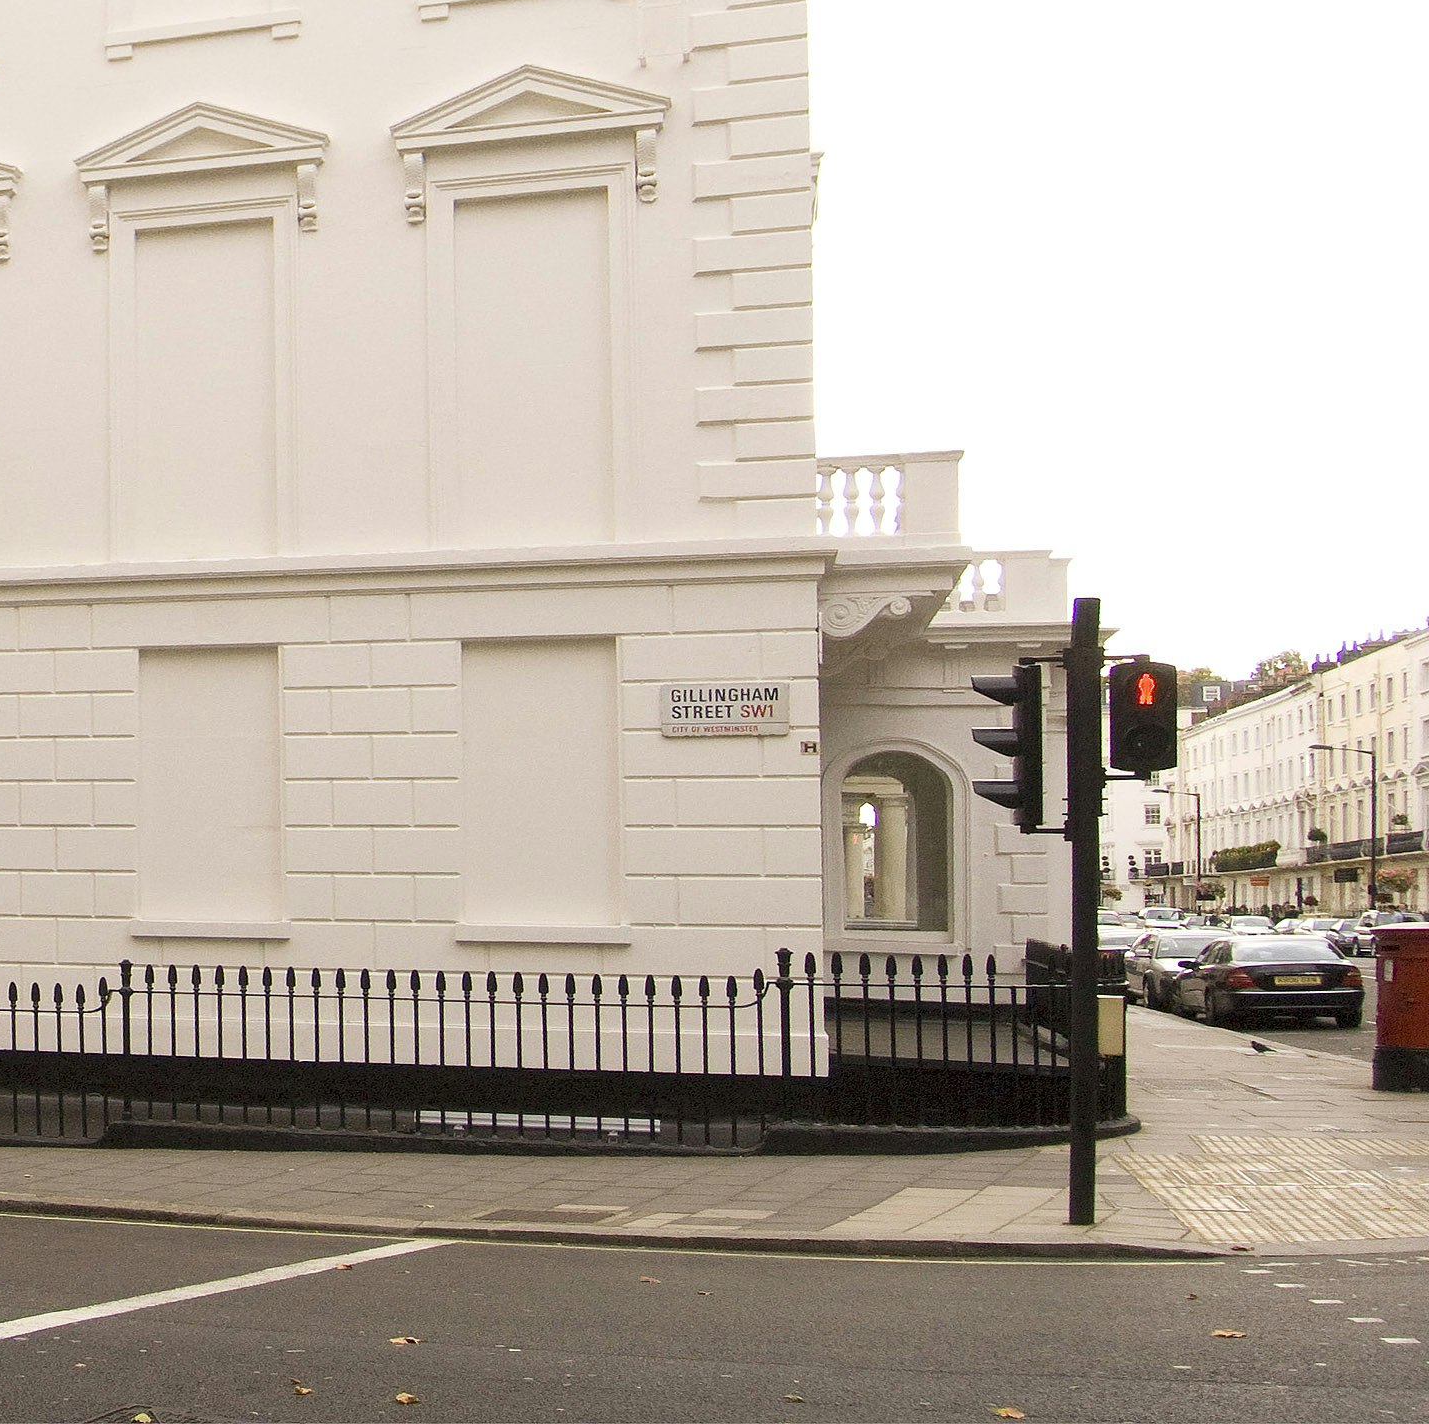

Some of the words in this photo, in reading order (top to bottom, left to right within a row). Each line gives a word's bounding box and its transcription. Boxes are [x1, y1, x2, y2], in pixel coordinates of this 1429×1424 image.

[671, 687, 779, 703] GILLINGHAM
[671, 705, 734, 719] STREET
[740, 704, 774, 718] SW1
[703, 725, 759, 733] WESTMINSTER
